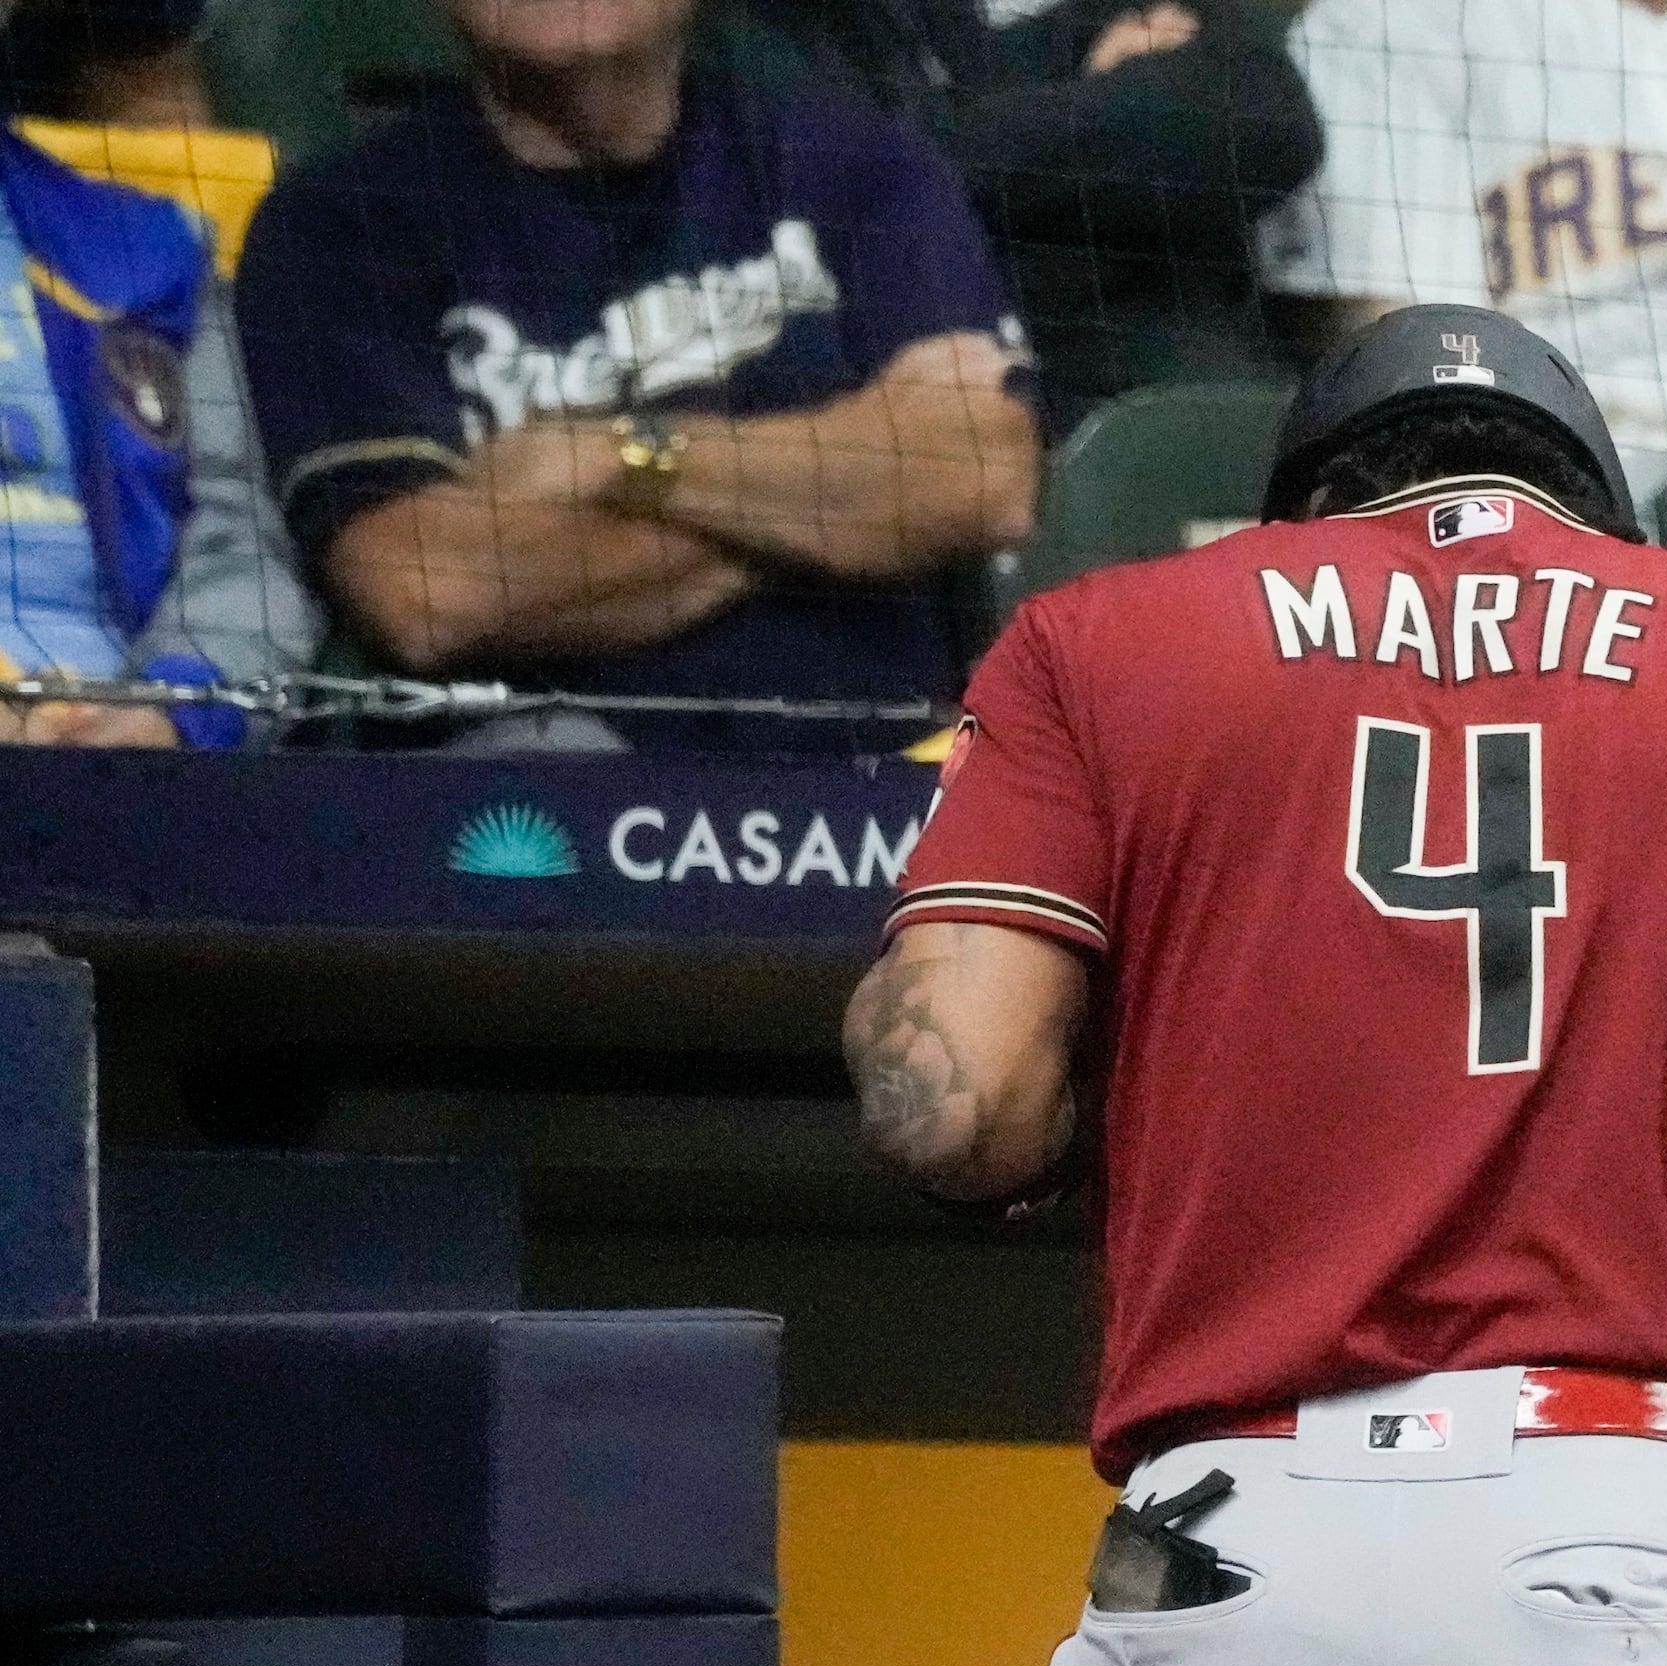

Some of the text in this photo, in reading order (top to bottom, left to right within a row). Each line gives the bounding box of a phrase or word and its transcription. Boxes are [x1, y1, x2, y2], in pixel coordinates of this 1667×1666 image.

[1441, 334, 1481, 366] 4
[1260, 564, 1655, 683] MARTE
[1345, 716, 1567, 1076] 4
